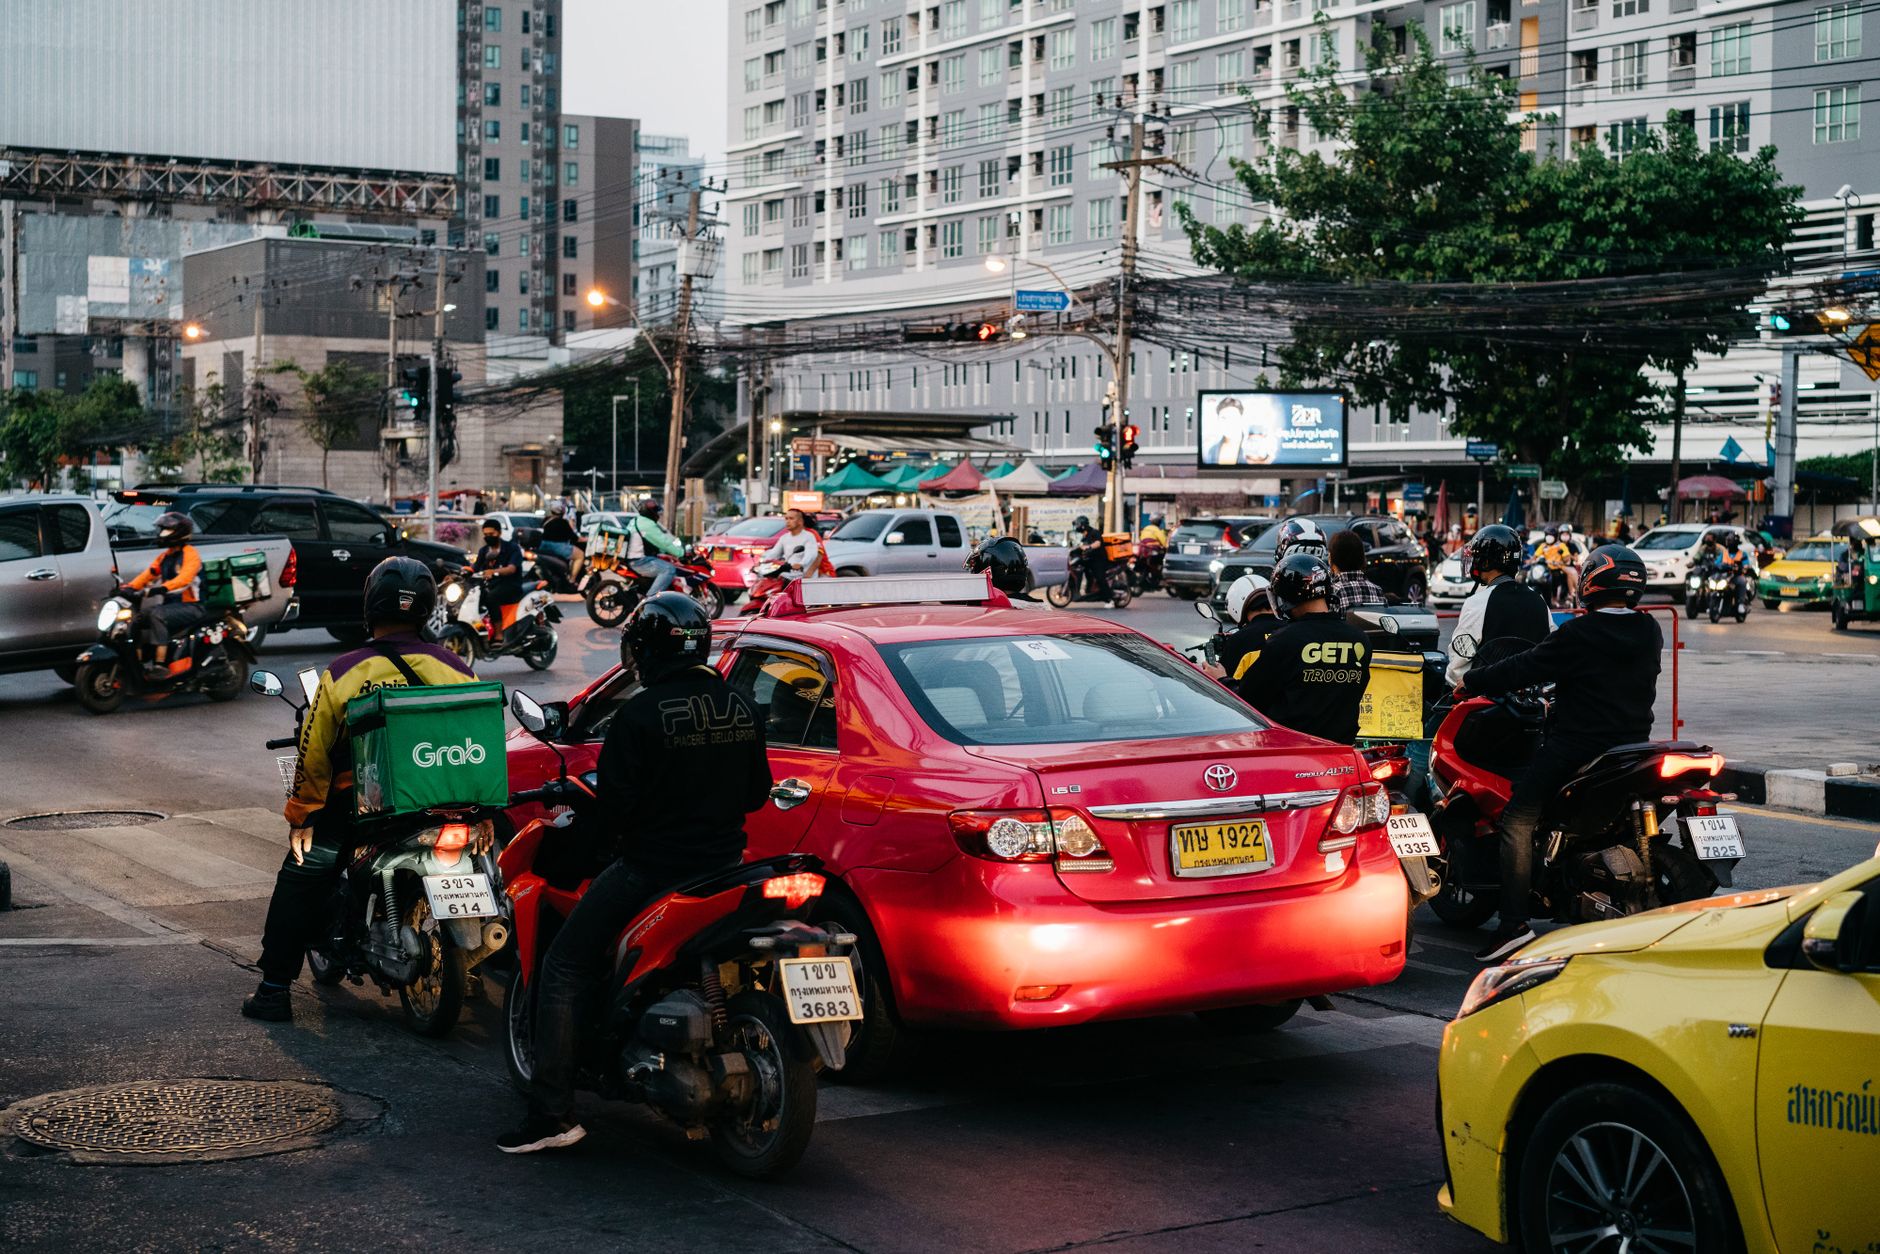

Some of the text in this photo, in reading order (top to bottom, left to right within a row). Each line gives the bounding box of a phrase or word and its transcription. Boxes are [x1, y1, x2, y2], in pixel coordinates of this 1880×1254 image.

[658, 691, 754, 736] FILA
[412, 737, 486, 768] Grab
[1217, 824, 1263, 850] 1922
[1396, 841, 1431, 855] 1335
[1703, 845, 1738, 858] 7825
[433, 891, 490, 903] กรุงเทพมหานคร
[448, 902, 481, 915] 614
[790, 984, 853, 1000] กรุงเทพมหานคร
[801, 1000, 850, 1019] 3683
